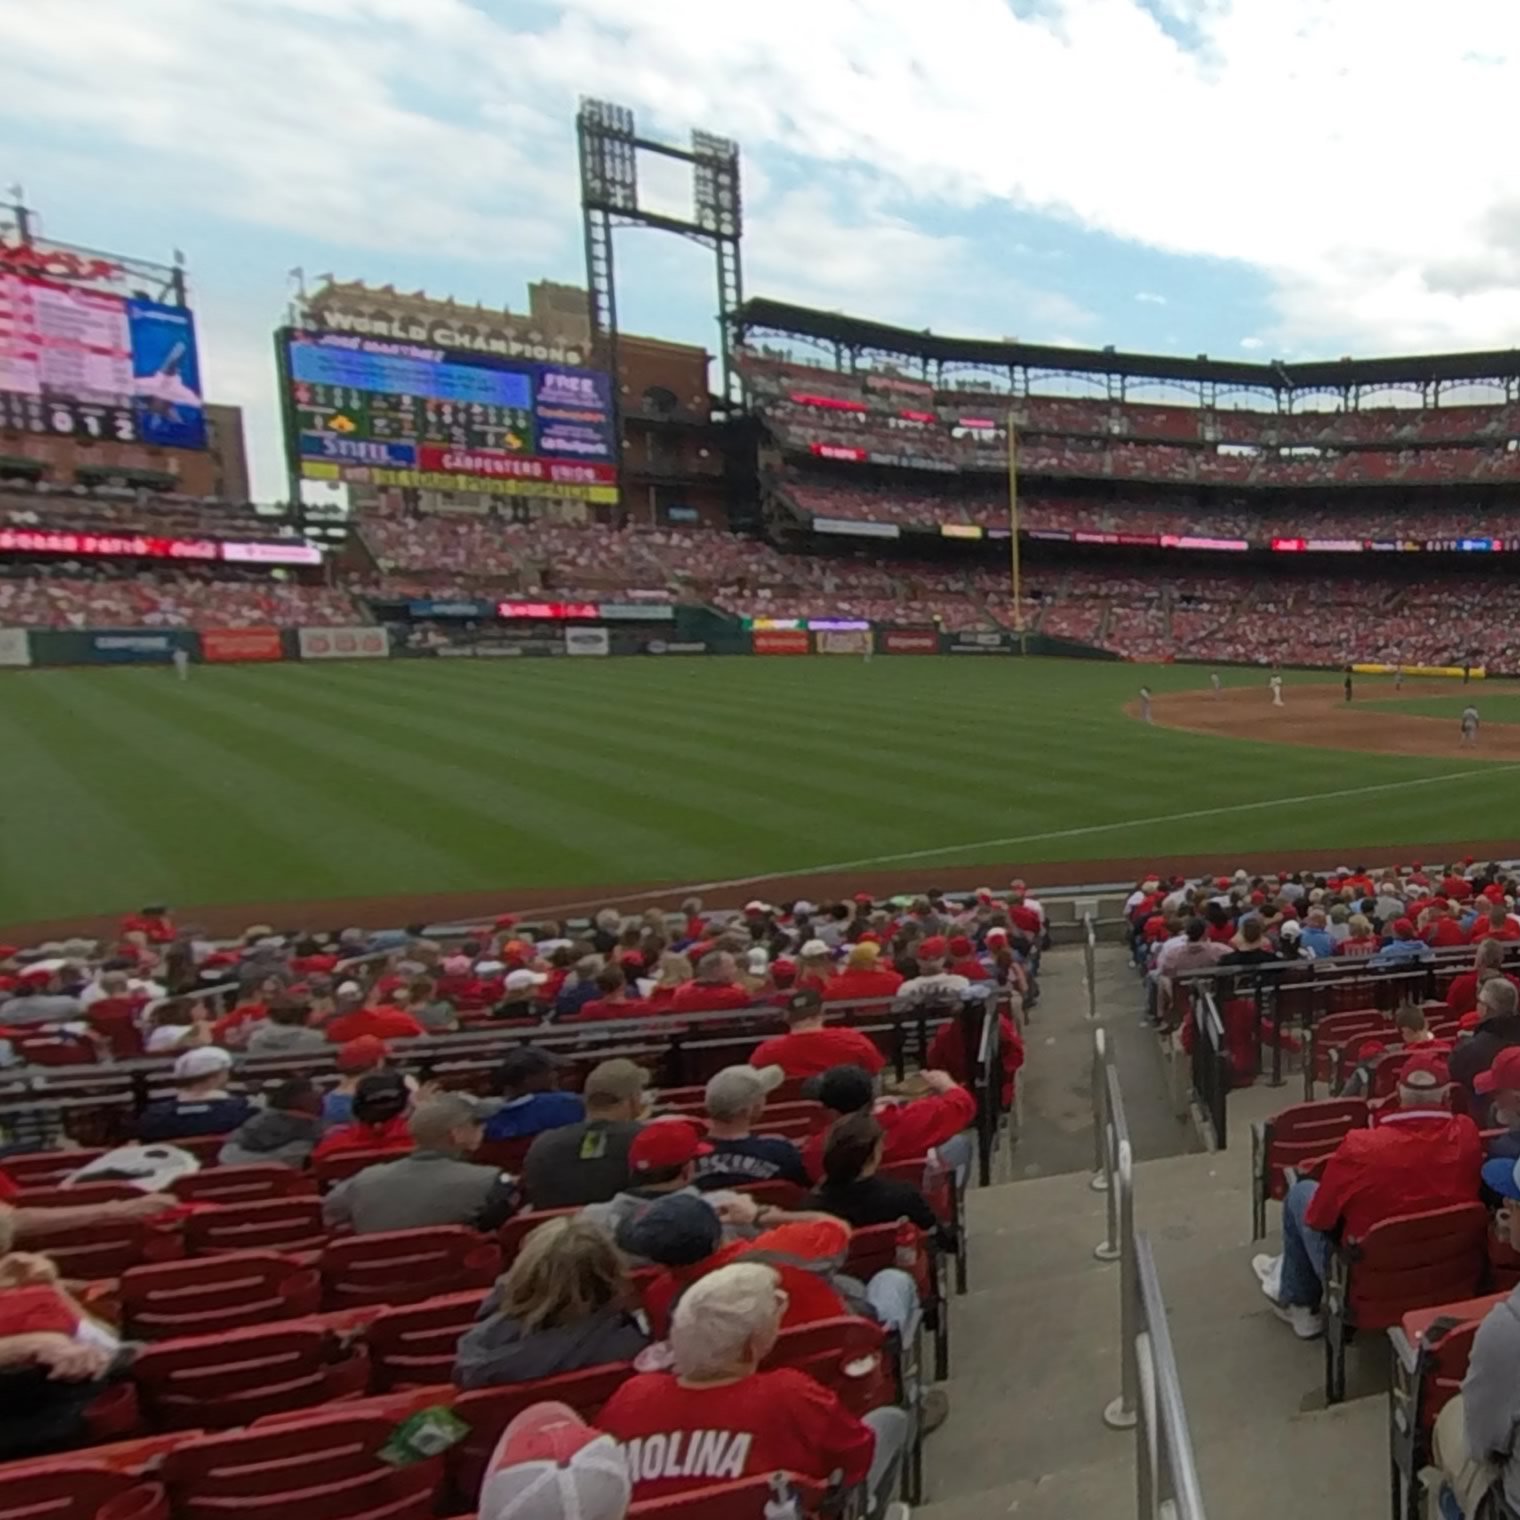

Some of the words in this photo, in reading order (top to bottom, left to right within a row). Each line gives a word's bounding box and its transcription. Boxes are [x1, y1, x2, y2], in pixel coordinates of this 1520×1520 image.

[323, 311, 428, 341] WORLD
[432, 327, 581, 366] CHAMPIONS
[617, 1429, 753, 1483] MOLINA
